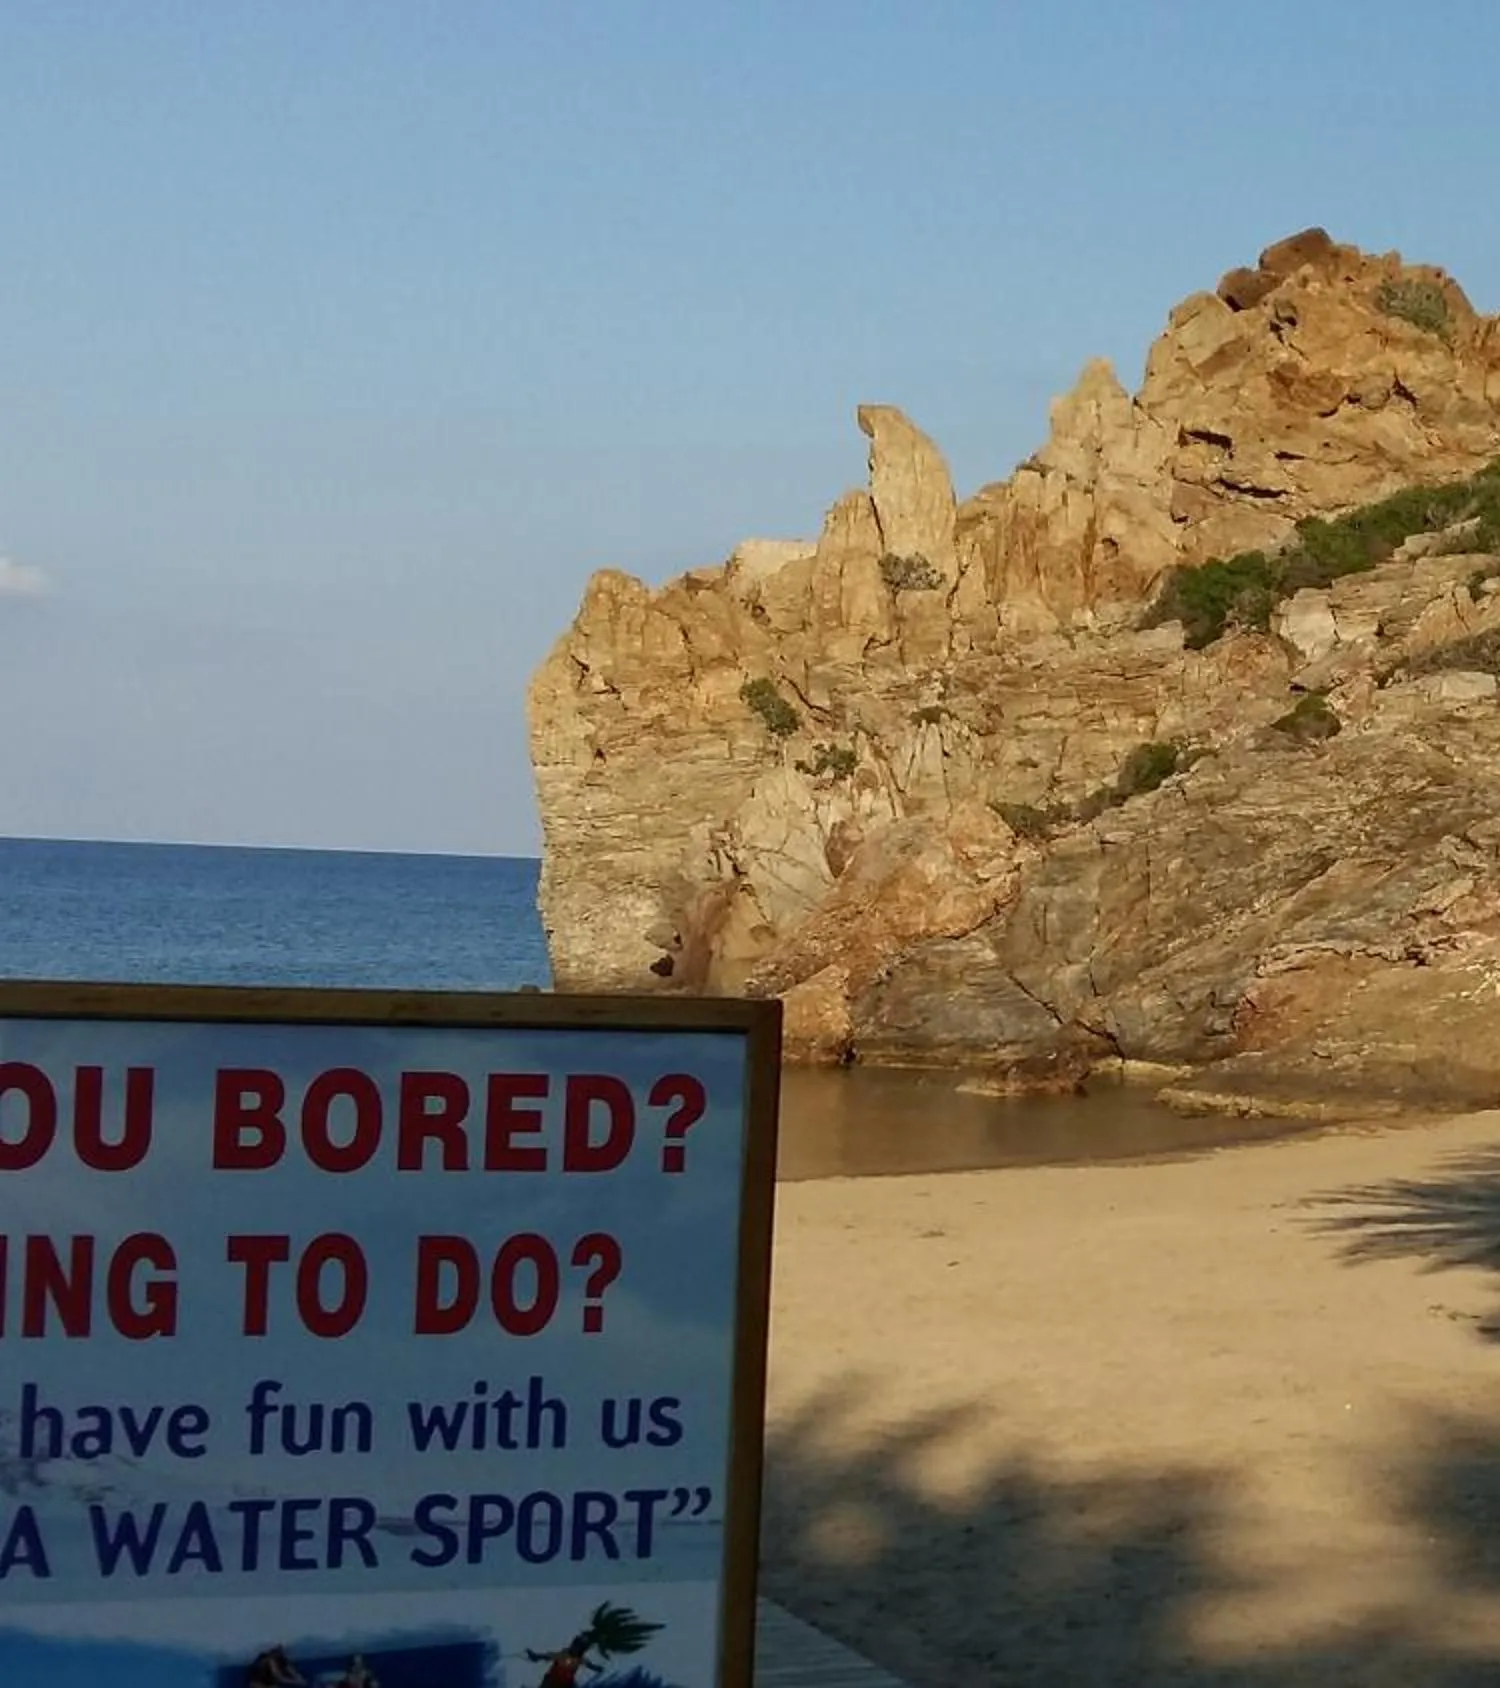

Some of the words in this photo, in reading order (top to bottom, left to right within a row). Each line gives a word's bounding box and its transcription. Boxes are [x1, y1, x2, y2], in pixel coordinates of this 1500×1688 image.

[0, 1062, 154, 1170] OU
[212, 1067, 707, 1173] BORED?
[227, 1233, 368, 1338] TO
[414, 1232, 623, 1336] DO?
[19, 1382, 210, 1460] have
[245, 1379, 373, 1455] fun
[407, 1375, 567, 1452] with
[600, 1396, 683, 1448] us
[0, 1504, 51, 1579] A
[89, 1498, 379, 1577] WATER
